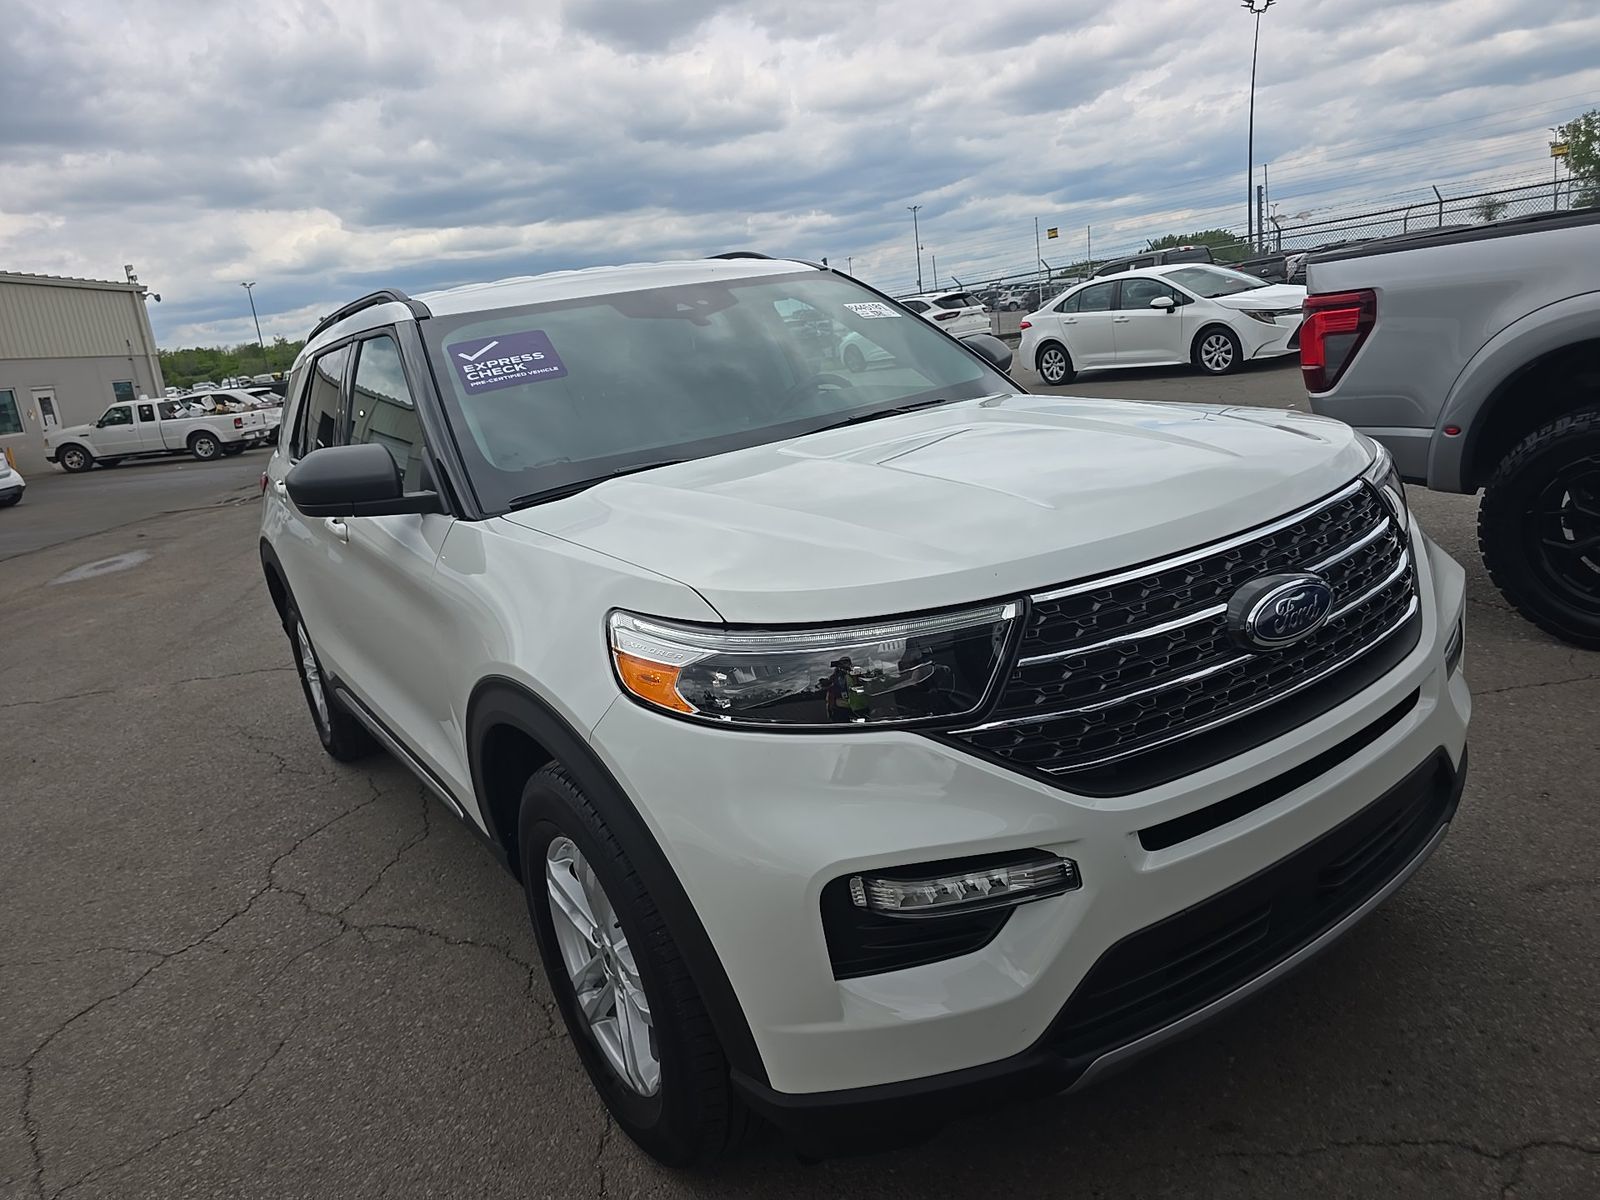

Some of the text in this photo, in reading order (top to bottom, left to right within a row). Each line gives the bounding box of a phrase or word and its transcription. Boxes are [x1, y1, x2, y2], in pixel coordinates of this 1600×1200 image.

[463, 352, 545, 373] EXPRESS
[466, 363, 528, 381] CHECK
[470, 366, 560, 388] PRE-CERTIFIED VEHICLE
[1274, 592, 1321, 634] Ford
